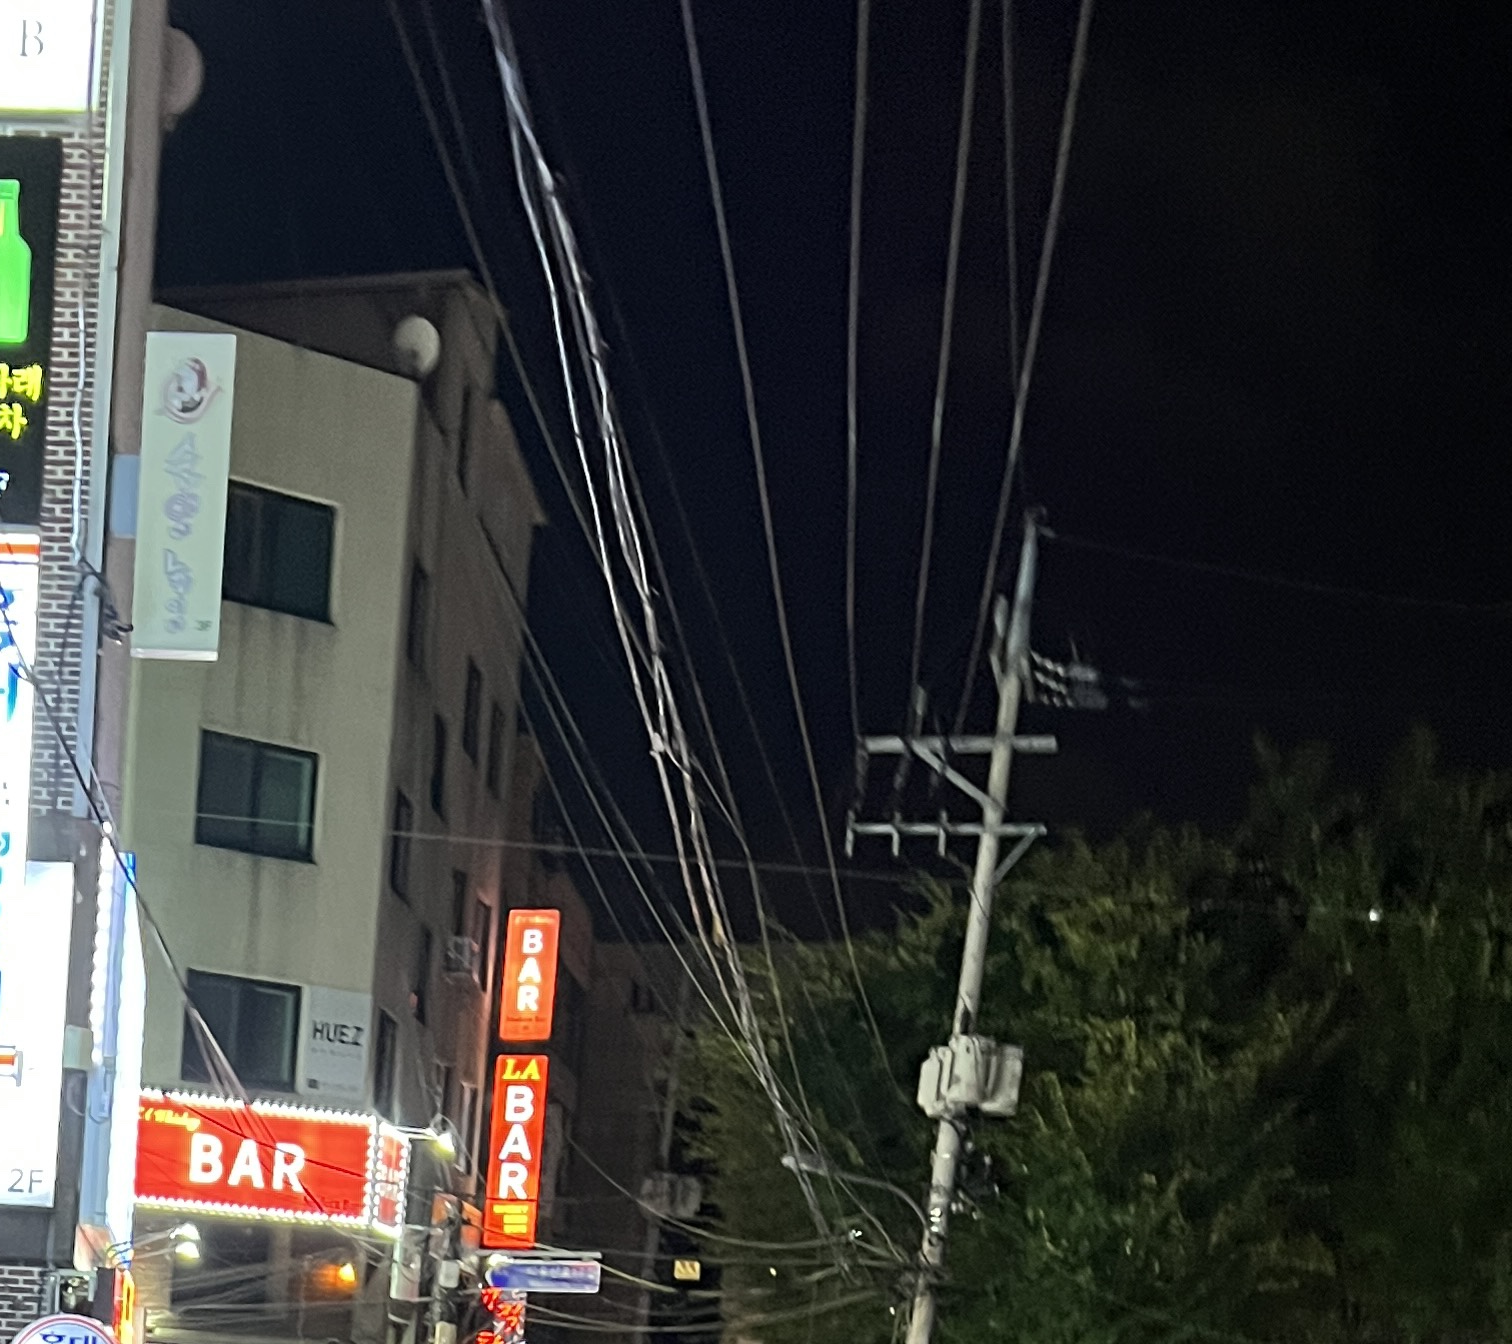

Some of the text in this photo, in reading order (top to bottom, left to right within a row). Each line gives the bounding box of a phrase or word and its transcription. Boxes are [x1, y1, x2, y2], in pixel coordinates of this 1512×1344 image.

[516, 929, 544, 1012] BAR
[312, 1021, 364, 1047] HUEZ
[502, 1058, 541, 1080] LA
[188, 1133, 306, 1193] BAR
[498, 1085, 534, 1200] BAR
[7, 1168, 45, 1193] 2F
